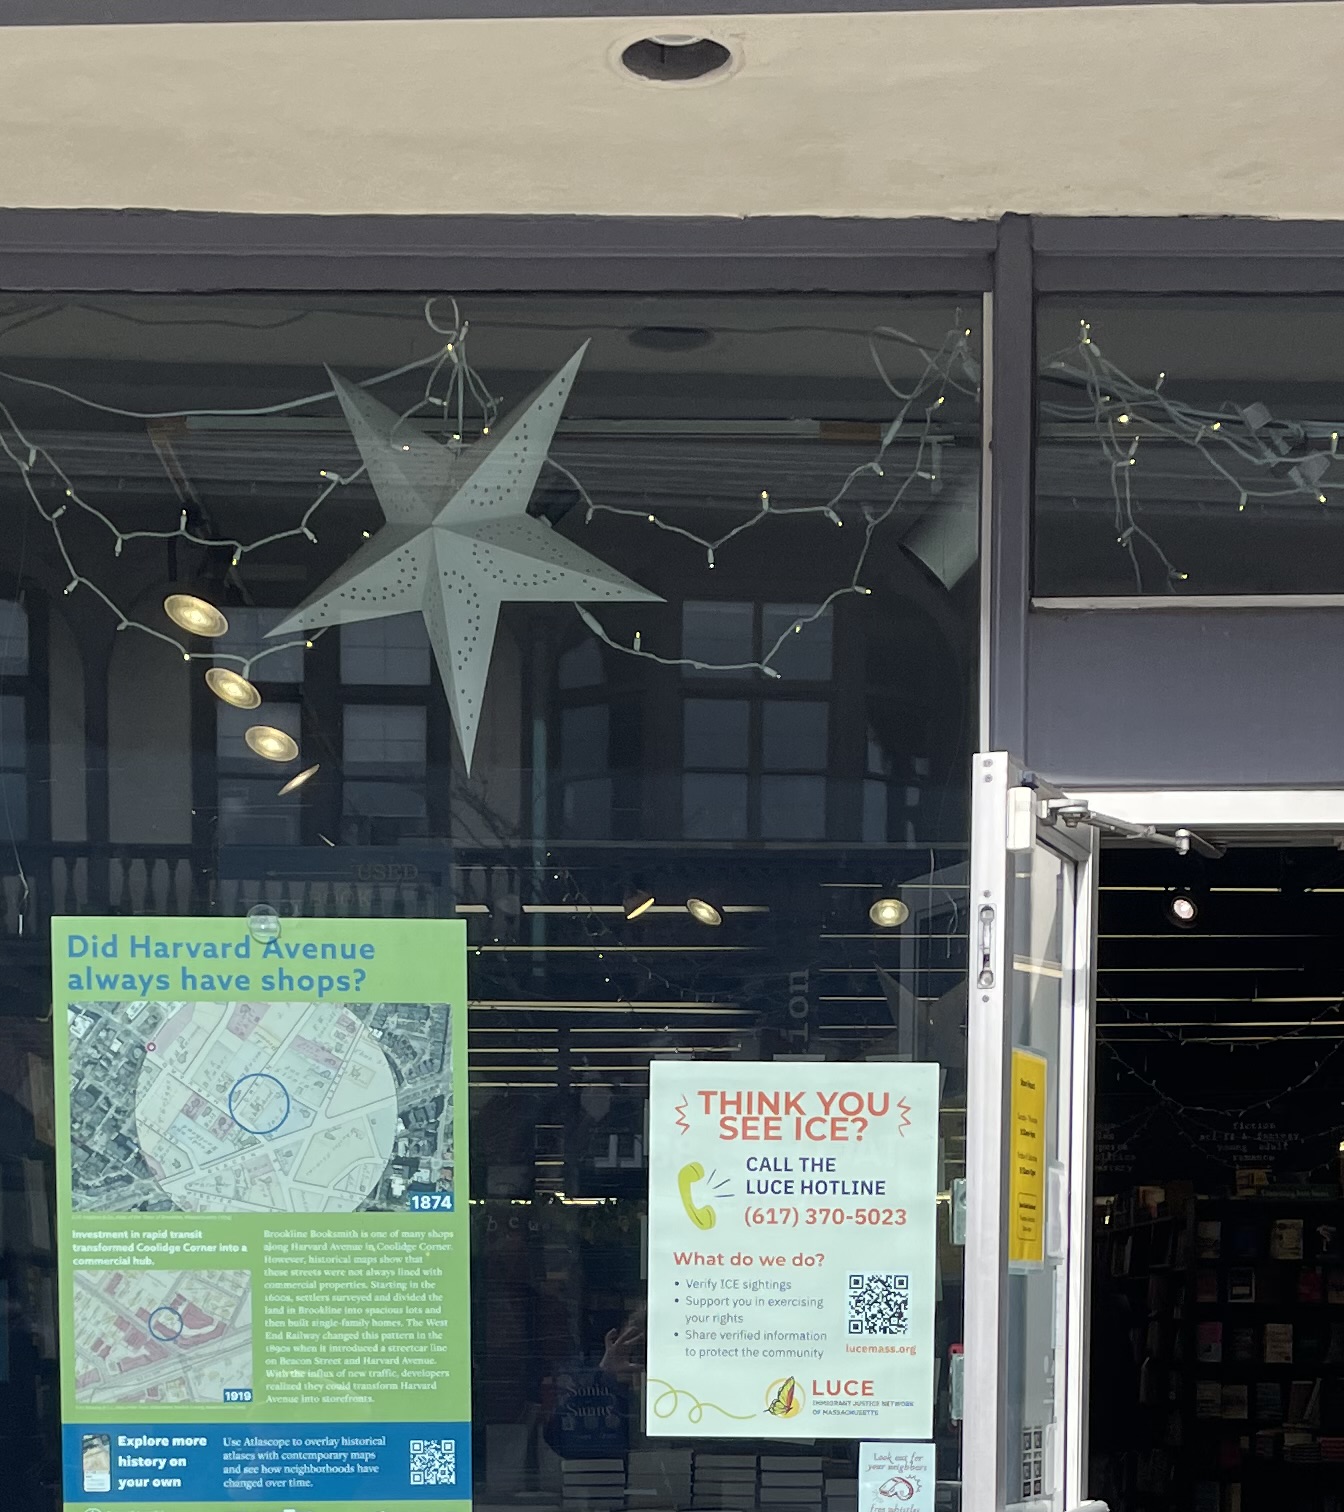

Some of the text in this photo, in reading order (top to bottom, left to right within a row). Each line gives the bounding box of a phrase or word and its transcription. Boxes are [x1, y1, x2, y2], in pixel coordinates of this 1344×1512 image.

[68, 935, 375, 959] Did Harvard Avenue
[68, 966, 366, 998] always have shops?
[697, 1091, 890, 1116] THINK YOU
[719, 1116, 868, 1141] SEE ICE?
[746, 1157, 836, 1172] CALL THE
[746, 1180, 886, 1195] LUCE HOTLINE
[412, 1195, 451, 1210] 1874
[744, 1207, 907, 1227] (617) 370-5023
[72, 1230, 202, 1240] Investment in rapid transit
[72, 1256, 155, 1266] commercial hub.
[673, 1252, 825, 1267] What do we do?
[686, 1279, 792, 1292] Verify ICE sightings
[685, 1297, 824, 1309] Support you in exercising
[685, 1314, 743, 1326] your rights
[685, 1330, 827, 1341] Share verified information
[685, 1348, 824, 1360] to protect the community
[845, 1344, 916, 1356] lucemass.org
[812, 1380, 874, 1397] LUCE
[225, 1391, 252, 1401] 1919
[118, 1435, 207, 1448] Explore more
[223, 1436, 386, 1448] Use Atlascope to overlay historical
[118, 1455, 187, 1470] history on
[118, 1478, 182, 1490] your own
